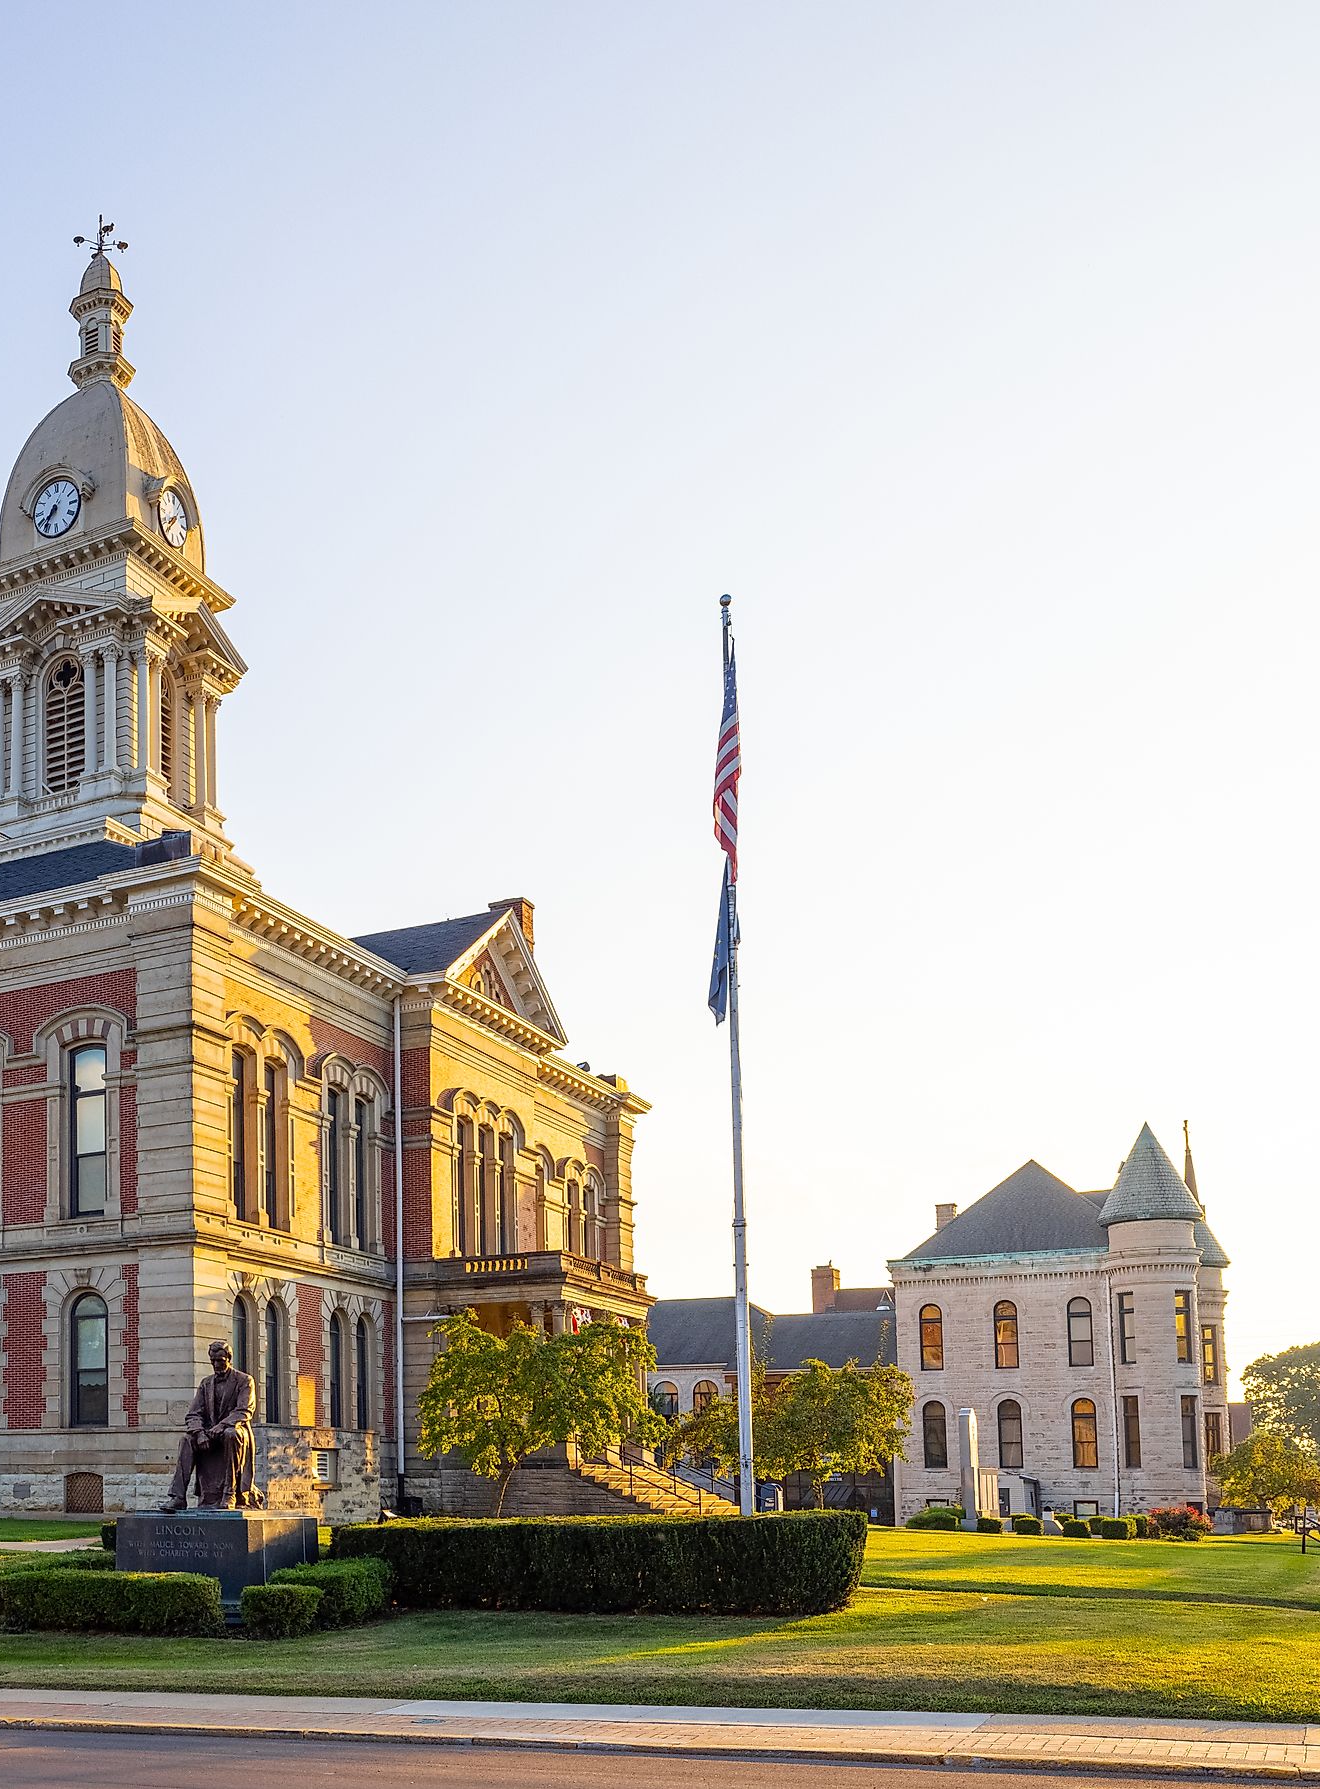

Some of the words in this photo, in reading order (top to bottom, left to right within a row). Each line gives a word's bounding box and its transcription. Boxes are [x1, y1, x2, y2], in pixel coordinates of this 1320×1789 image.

[155, 1525, 206, 1536] LINCOLN
[150, 1541, 174, 1549] MALICE
[179, 1541, 209, 1550] TOWARD
[159, 1549, 190, 1557] CHARITY
[194, 1550, 208, 1558] FOR
